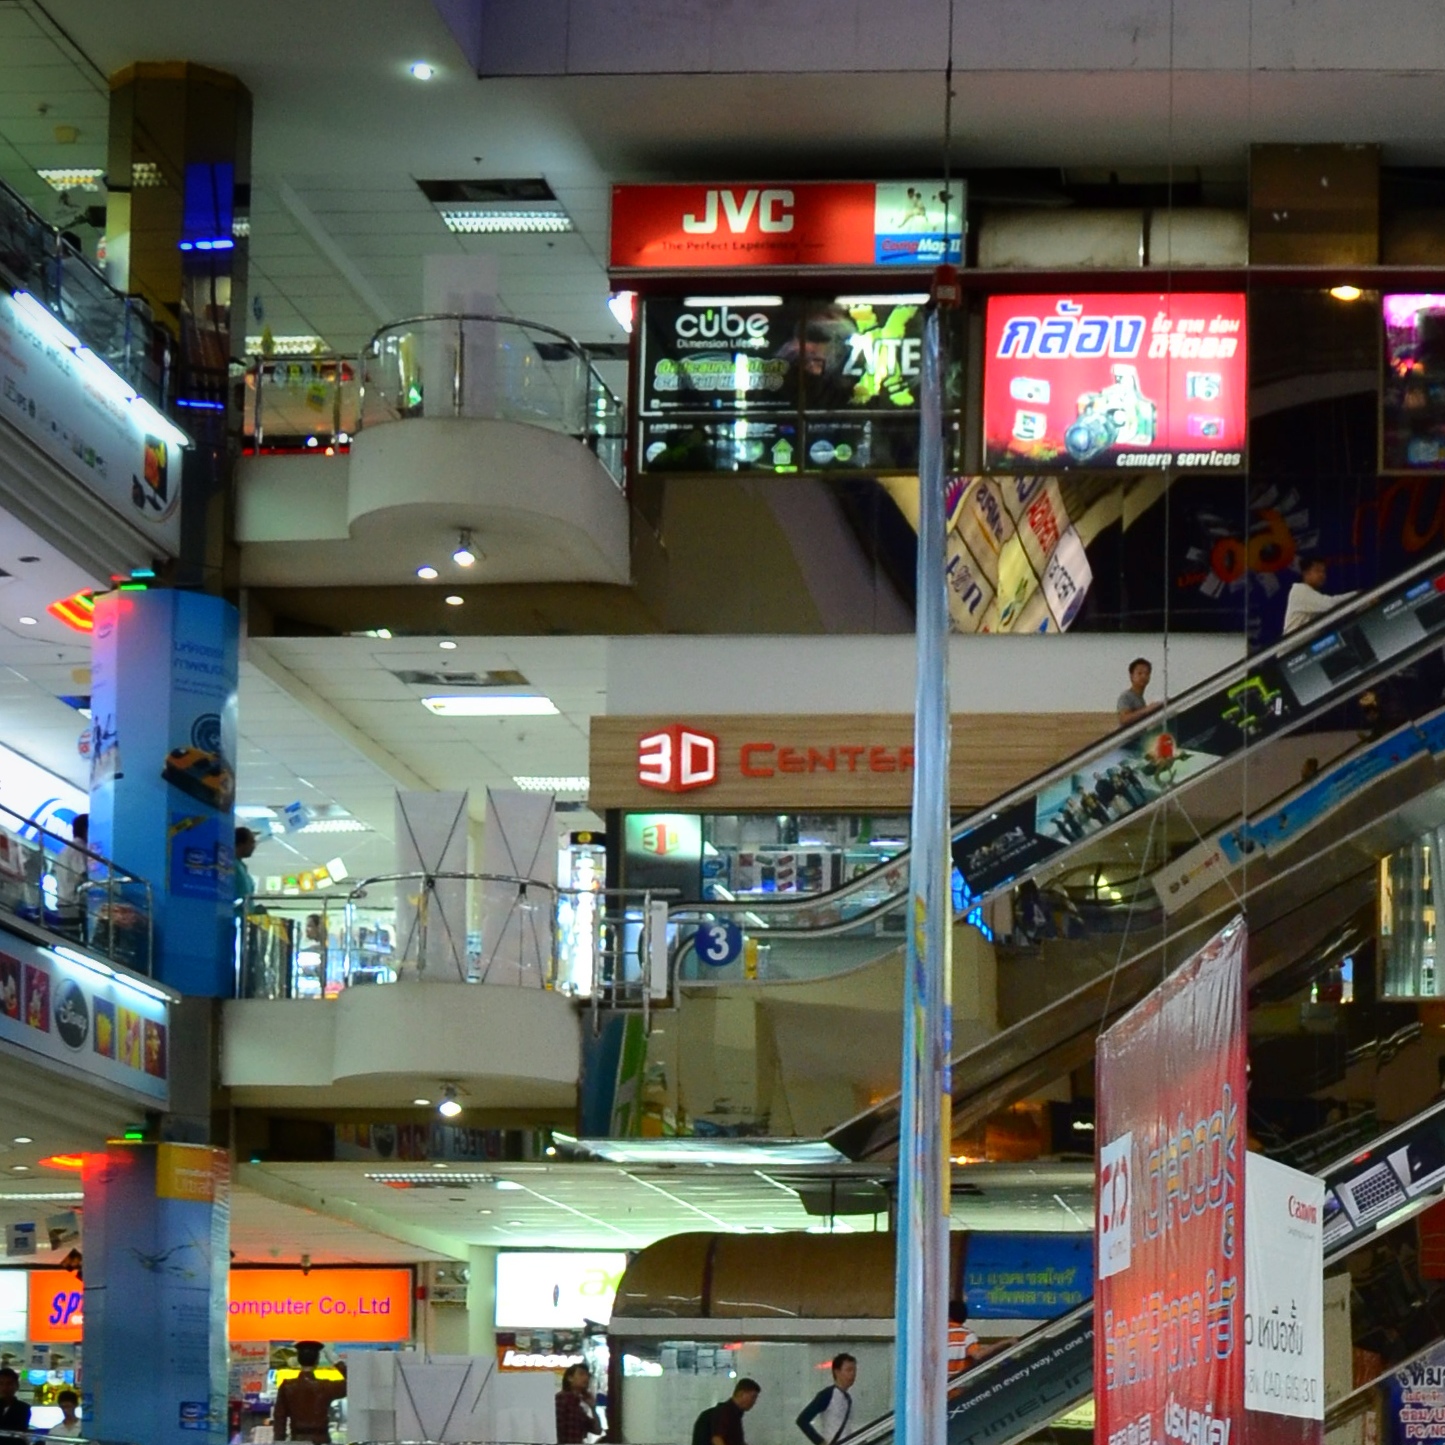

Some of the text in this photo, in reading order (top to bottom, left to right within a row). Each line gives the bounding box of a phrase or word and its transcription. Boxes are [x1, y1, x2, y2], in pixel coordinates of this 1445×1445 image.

[683, 189, 795, 234] JVC
[686, 241, 728, 252] Perfect
[675, 304, 770, 338] cube
[996, 299, 1147, 358] กล้อง
[677, 338, 729, 350] Dimension
[1116, 451, 1241, 468] camera services
[638, 731, 719, 786] 3D
[706, 926, 731, 961] 3
[1288, 1193, 1318, 1225] Canon
[228, 1294, 392, 1319] omputer Co.,Ltd
